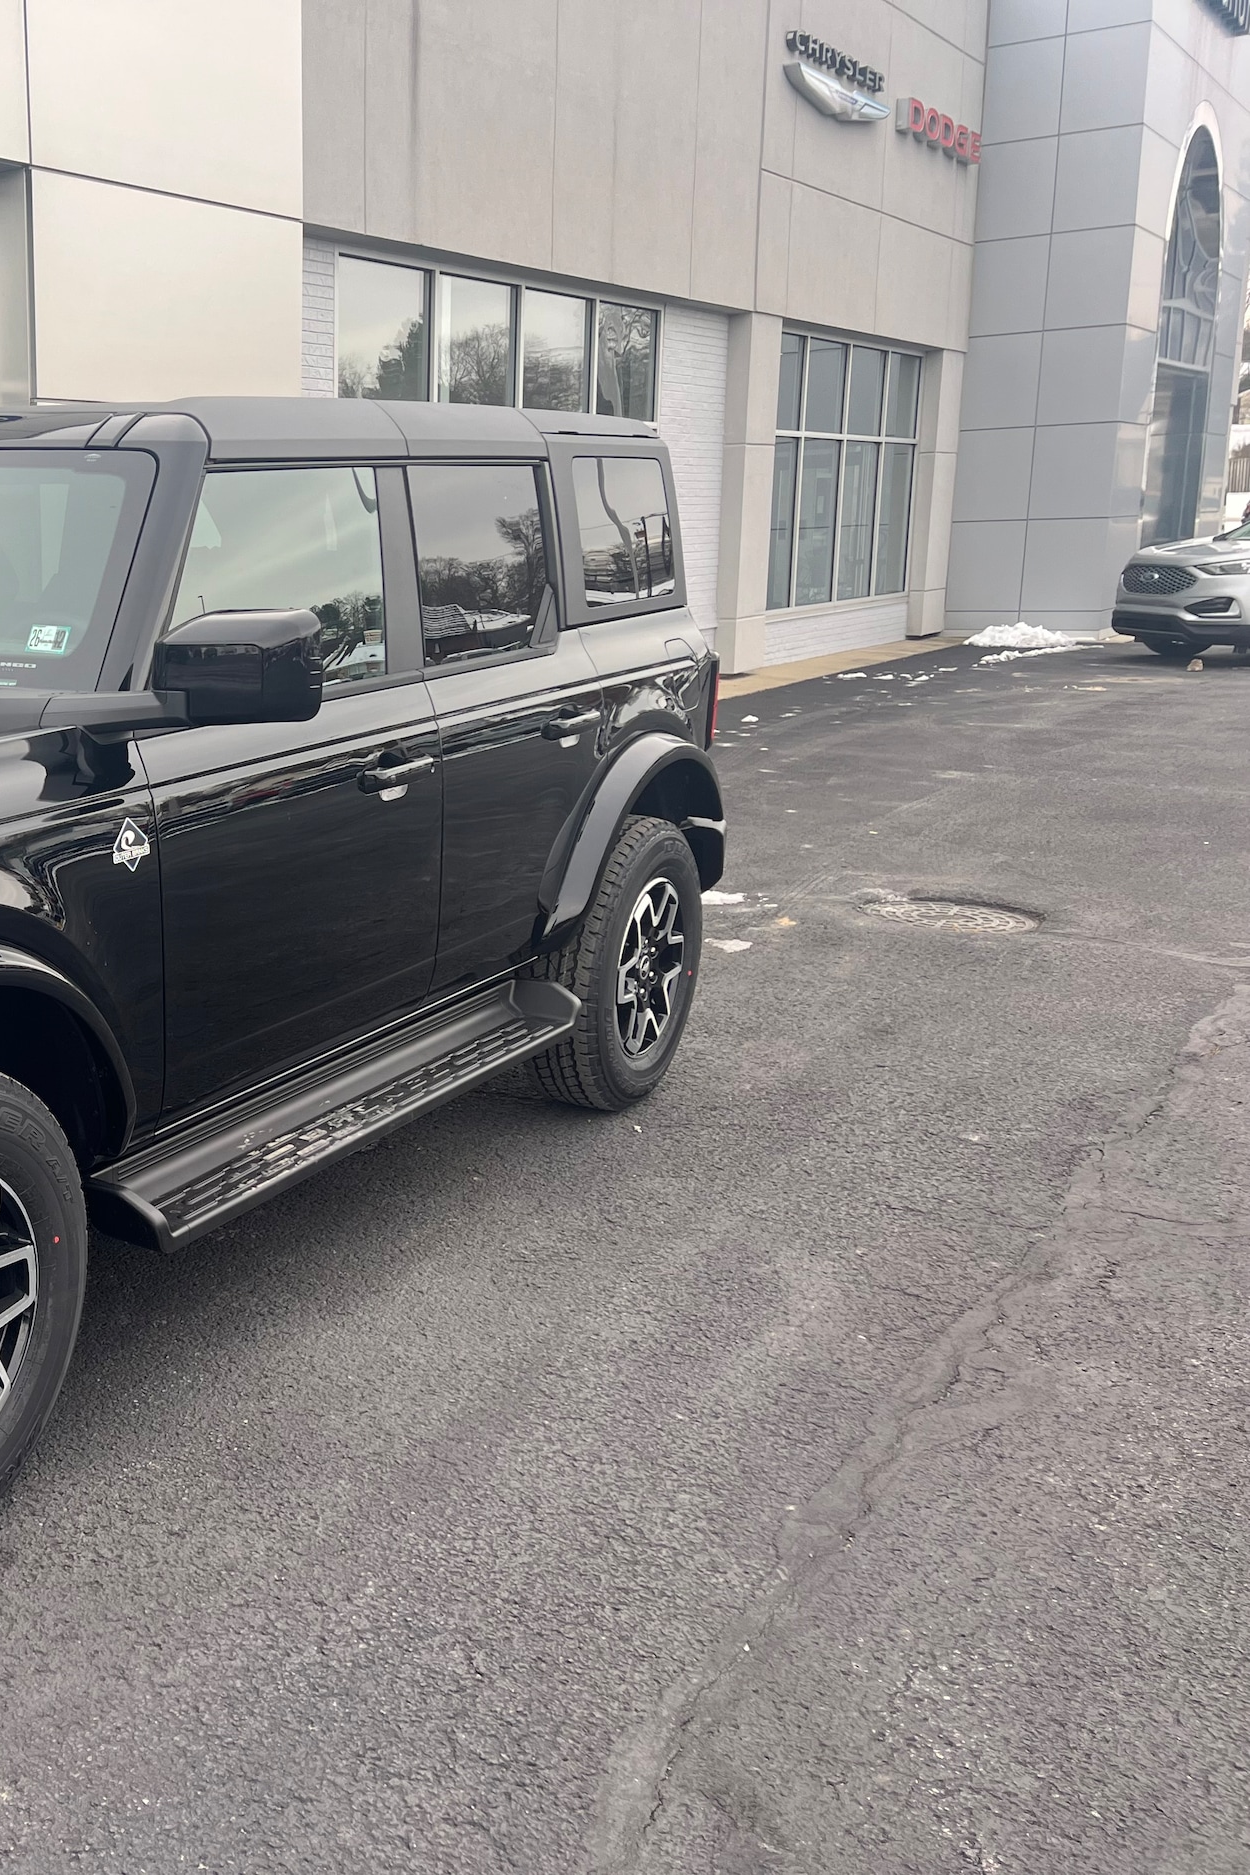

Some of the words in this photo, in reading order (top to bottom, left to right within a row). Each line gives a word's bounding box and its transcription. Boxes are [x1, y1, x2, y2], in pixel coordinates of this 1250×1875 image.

[792, 29, 886, 92] CHRYSLER
[907, 97, 982, 164] DODGE
[29, 629, 42, 647] 26
[46, 1154, 75, 1205] A/T
